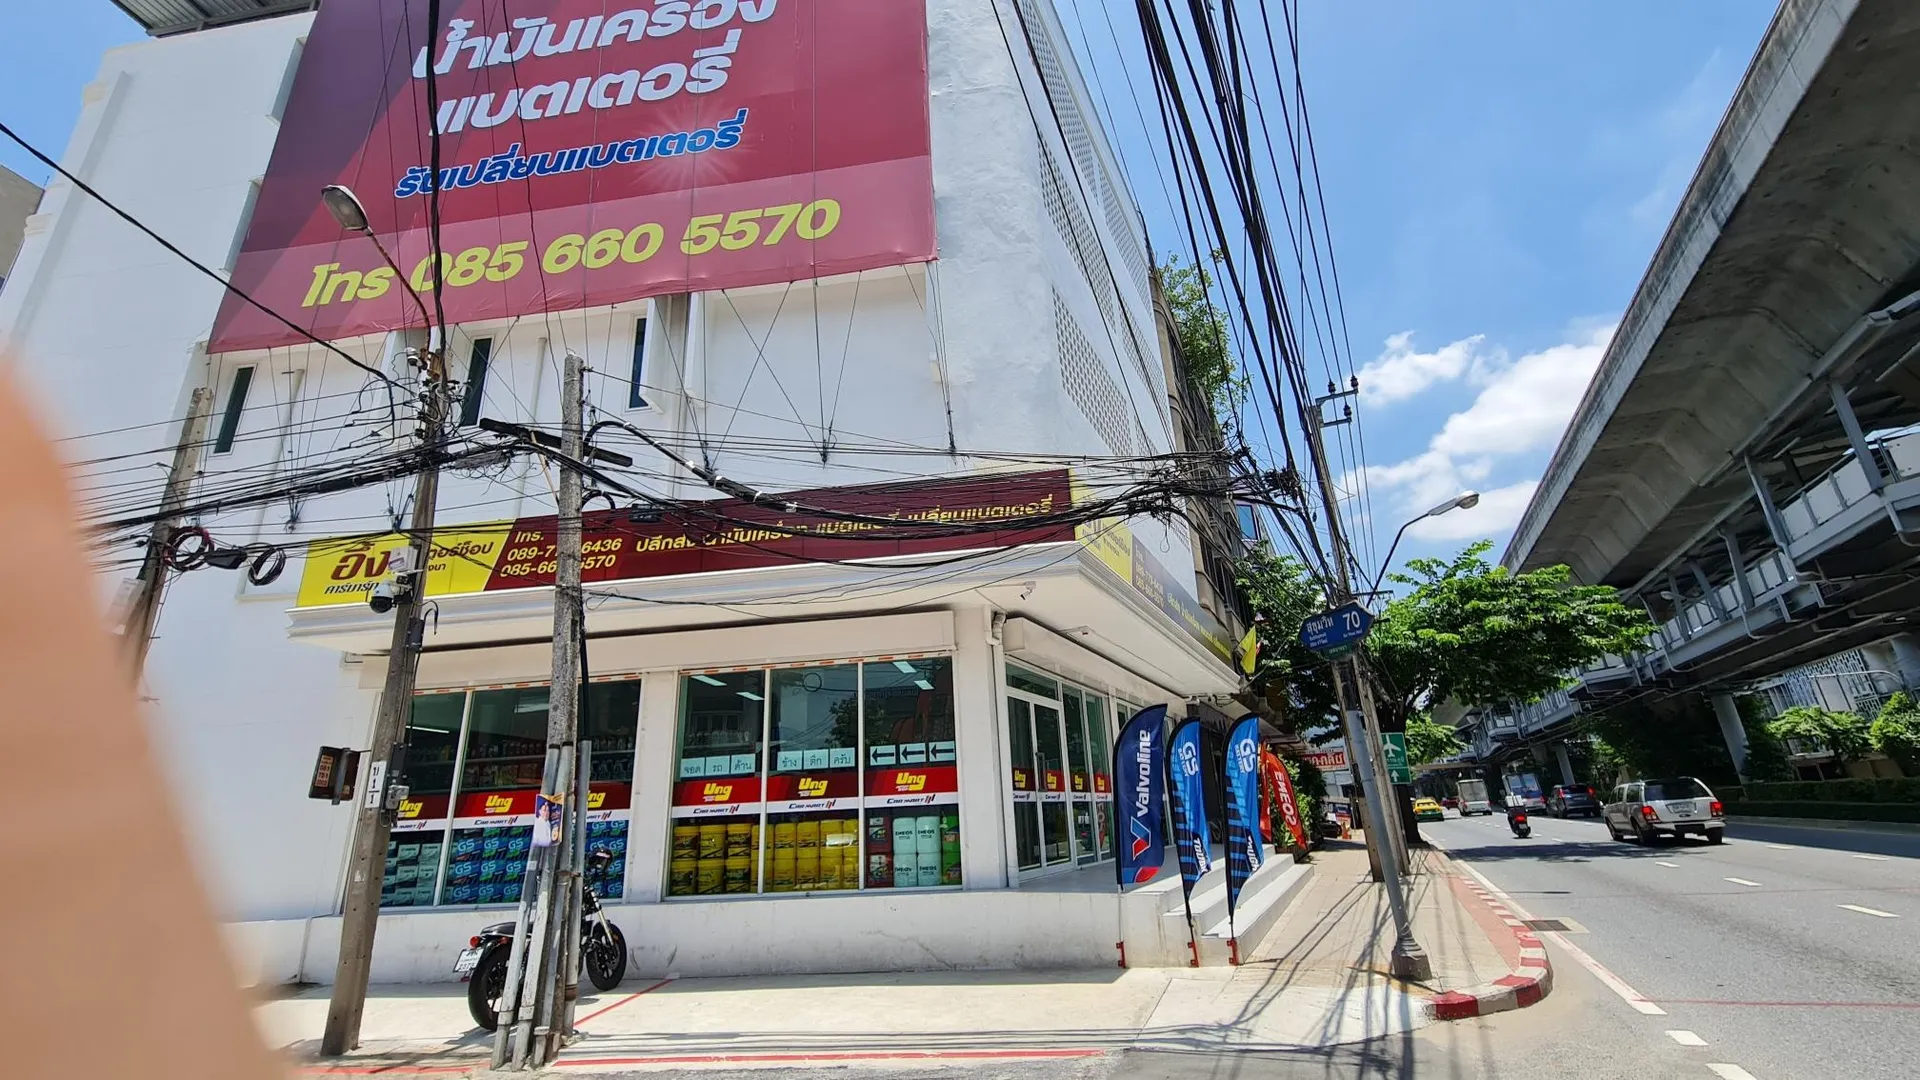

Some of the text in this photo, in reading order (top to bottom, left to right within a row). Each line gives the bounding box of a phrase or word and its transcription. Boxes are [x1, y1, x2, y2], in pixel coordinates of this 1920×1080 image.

[412, 0, 777, 79] น้ำมันเครอง
[428, 28, 742, 137] แบตเตอรี่
[395, 108, 749, 198] รับเปลี่ยนแบตเตอรี่
[301, 198, 841, 308] โทร 085 660 5570
[1342, 610, 1360, 631] 70
[1182, 741, 1199, 776] GS
[1240, 738, 1256, 773] GS
[798, 777, 828, 797] Ung
[895, 772, 926, 791] Ung
[1135, 729, 1151, 818] Valvoline
[485, 795, 513, 813] Ung
[587, 790, 606, 808] ng
[703, 783, 733, 802] Ung
